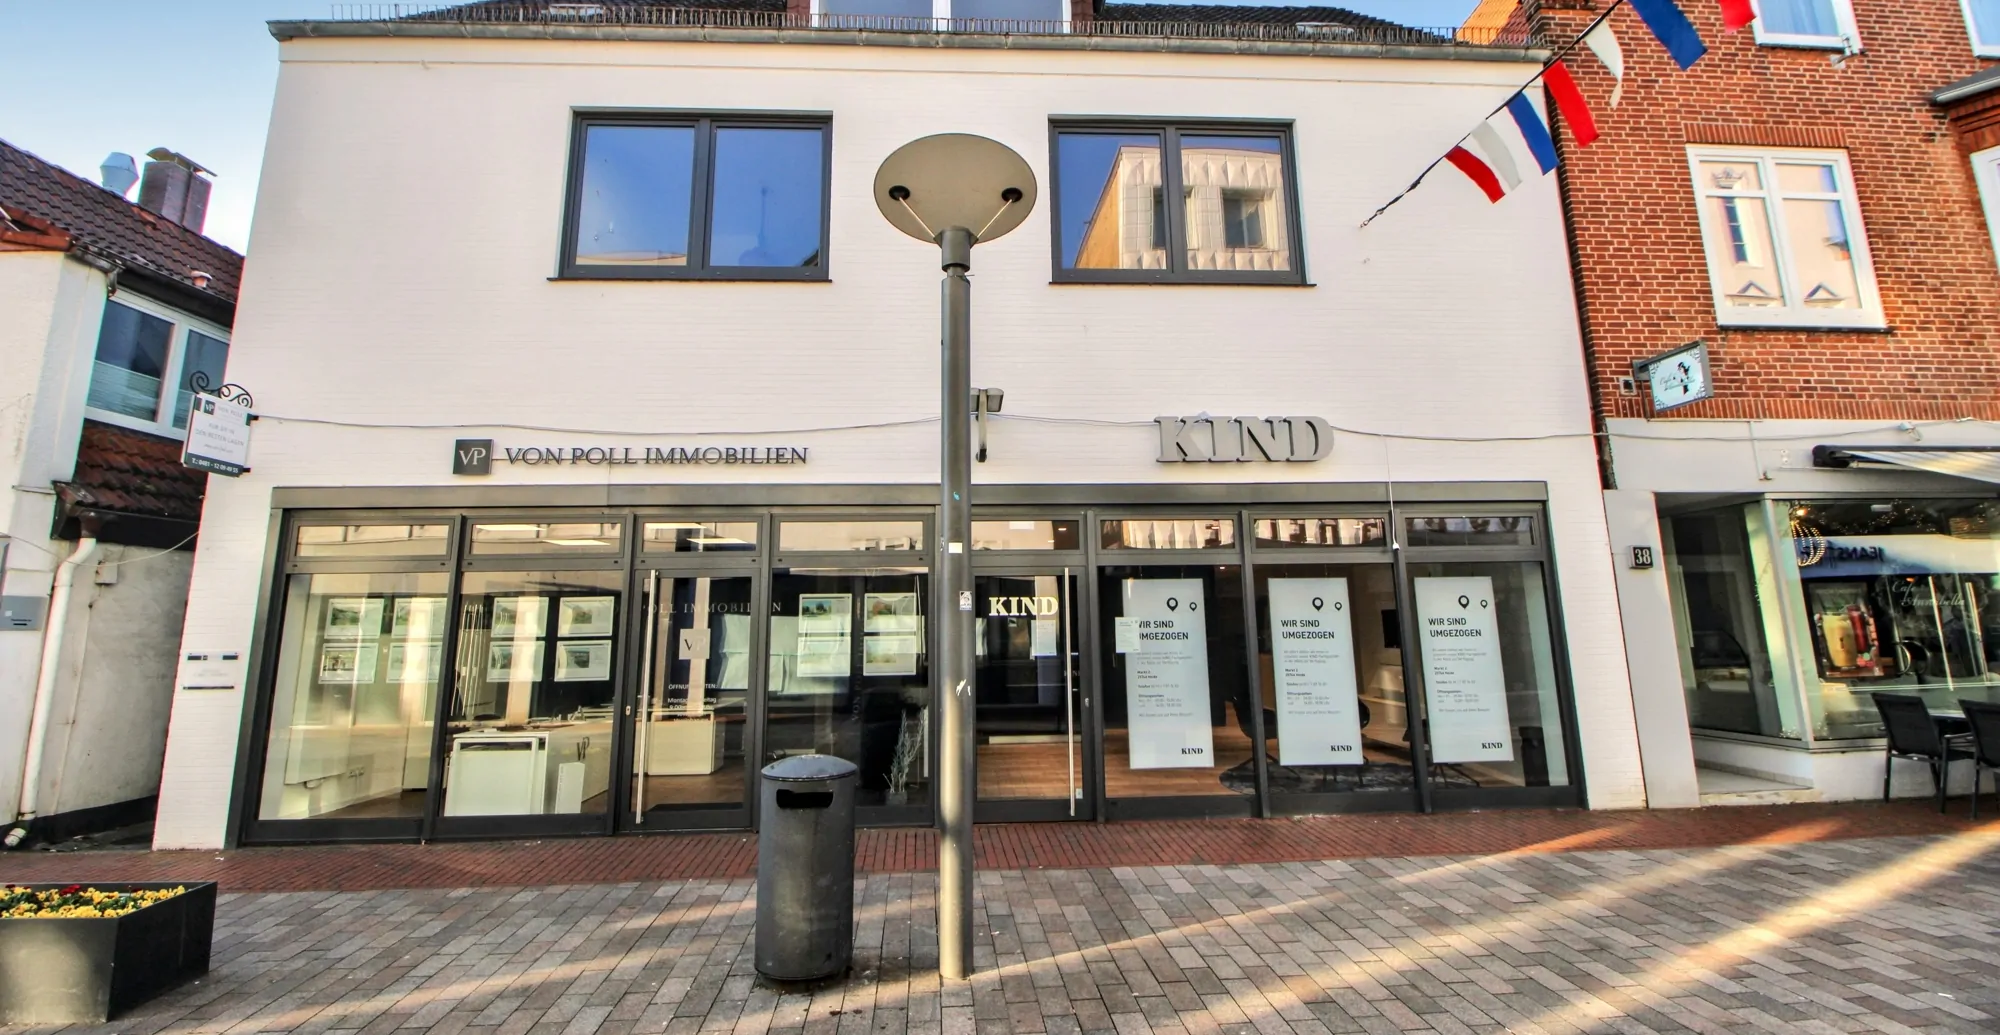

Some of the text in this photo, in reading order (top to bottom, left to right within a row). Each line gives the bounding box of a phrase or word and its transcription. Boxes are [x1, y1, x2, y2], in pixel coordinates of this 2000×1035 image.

[1154, 416, 1335, 462] KIND
[459, 447, 809, 465] VP VON POLL IMMOBILIEN
[1635, 548, 1651, 564] 38
[989, 596, 1059, 616] KIND
[1153, 620, 1174, 628] SIND
[1280, 619, 1320, 628] WIR SIND
[1428, 617, 1467, 626] WIR SIND
[1282, 631, 1335, 640] UMGEZOGEN
[1429, 629, 1482, 638] UMGEZOGEN
[1329, 744, 1353, 752] KIND
[1481, 742, 1503, 750] KIND
[1180, 747, 1204, 755] KIND
